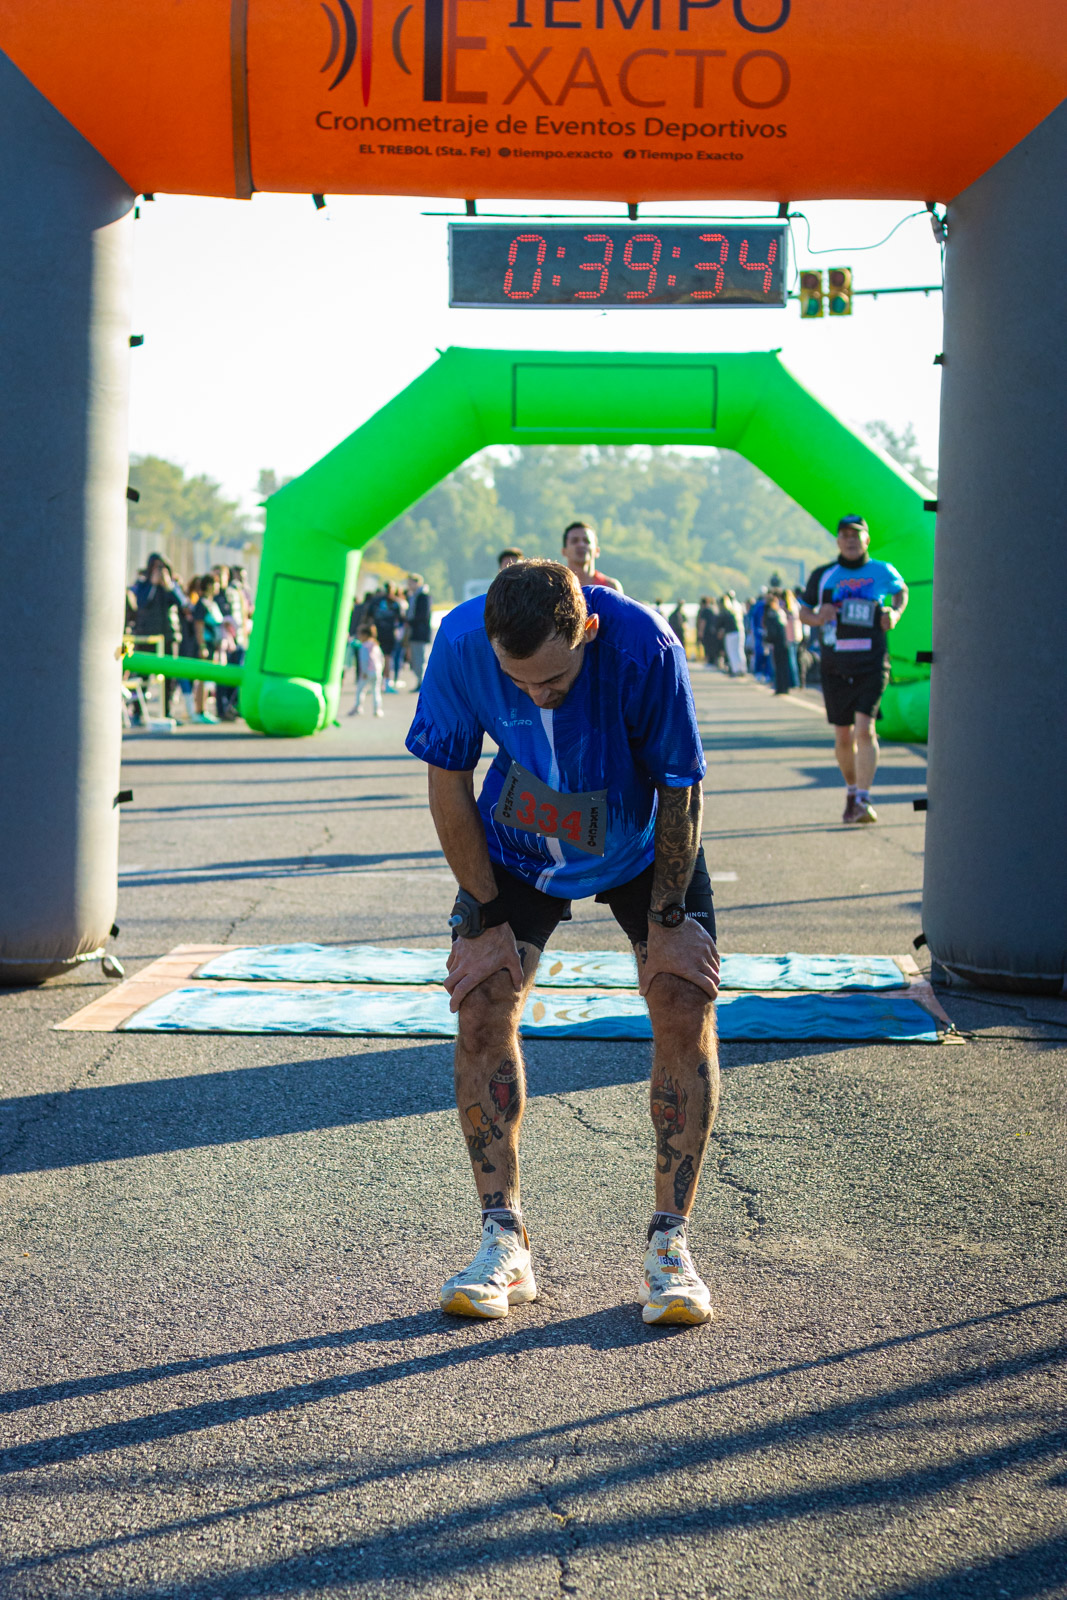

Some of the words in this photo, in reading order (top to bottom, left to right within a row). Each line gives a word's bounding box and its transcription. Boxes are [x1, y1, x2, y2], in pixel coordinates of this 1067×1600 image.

[315, 110, 489, 137] Cronometraje
[496, 114, 527, 134] de
[536, 116, 636, 136] Eventos
[645, 117, 788, 141] Deportivos
[359, 144, 376, 154] EL
[378, 145, 432, 156] TREBOL
[435, 146, 467, 157] (Sta.
[470, 147, 491, 157] Fe)
[513, 147, 613, 160] tiempo.exacto
[639, 149, 693, 161] Tiempo
[697, 150, 744, 160] Exacto
[503, 234, 778, 299] 0:39:34
[516, 791, 583, 841] 334
[483, 1191, 506, 1209] 22
